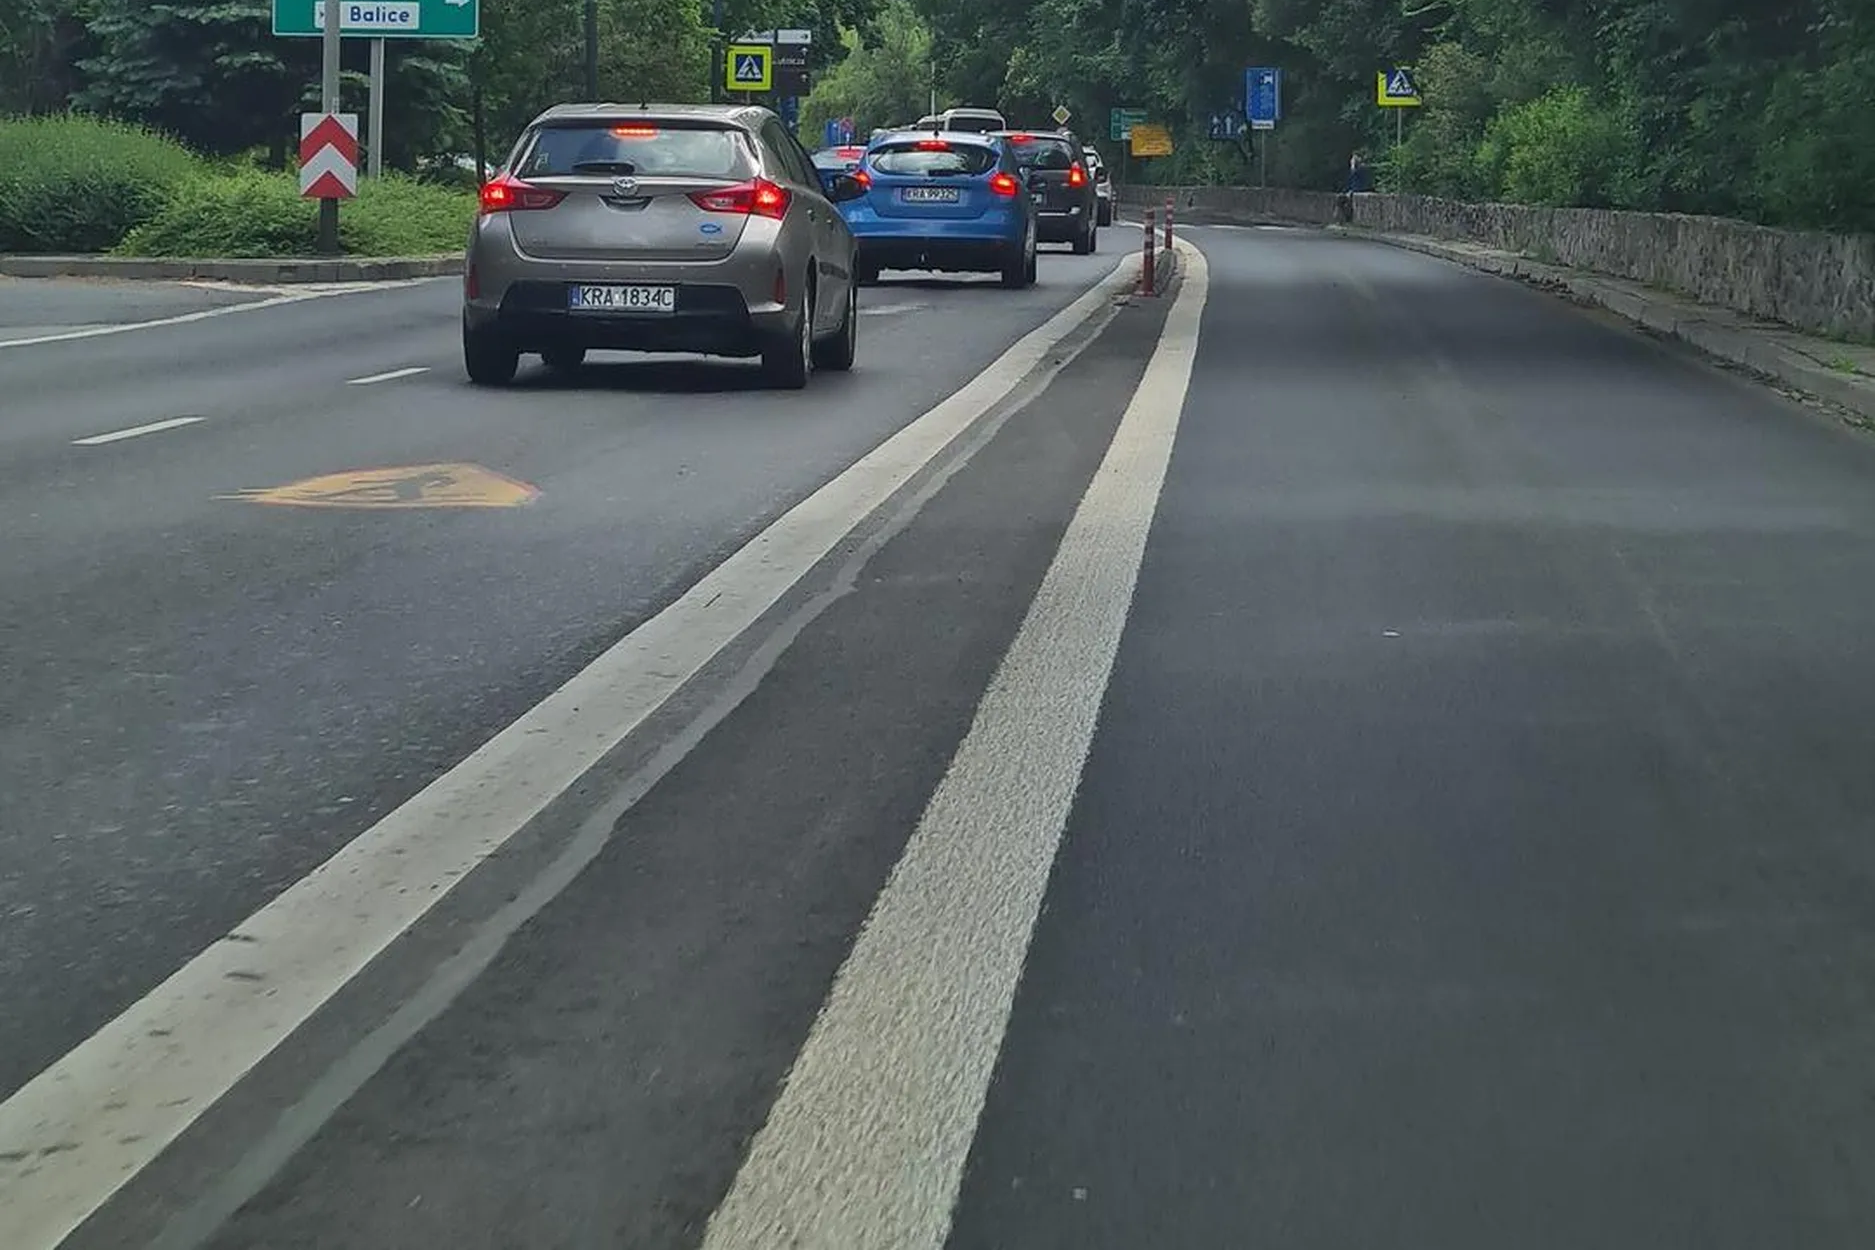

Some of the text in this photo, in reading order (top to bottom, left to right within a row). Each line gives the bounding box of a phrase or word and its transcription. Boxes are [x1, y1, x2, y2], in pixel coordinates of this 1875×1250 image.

[350, 5, 410, 23] Balice
[581, 288, 673, 307] KRA 1834C
